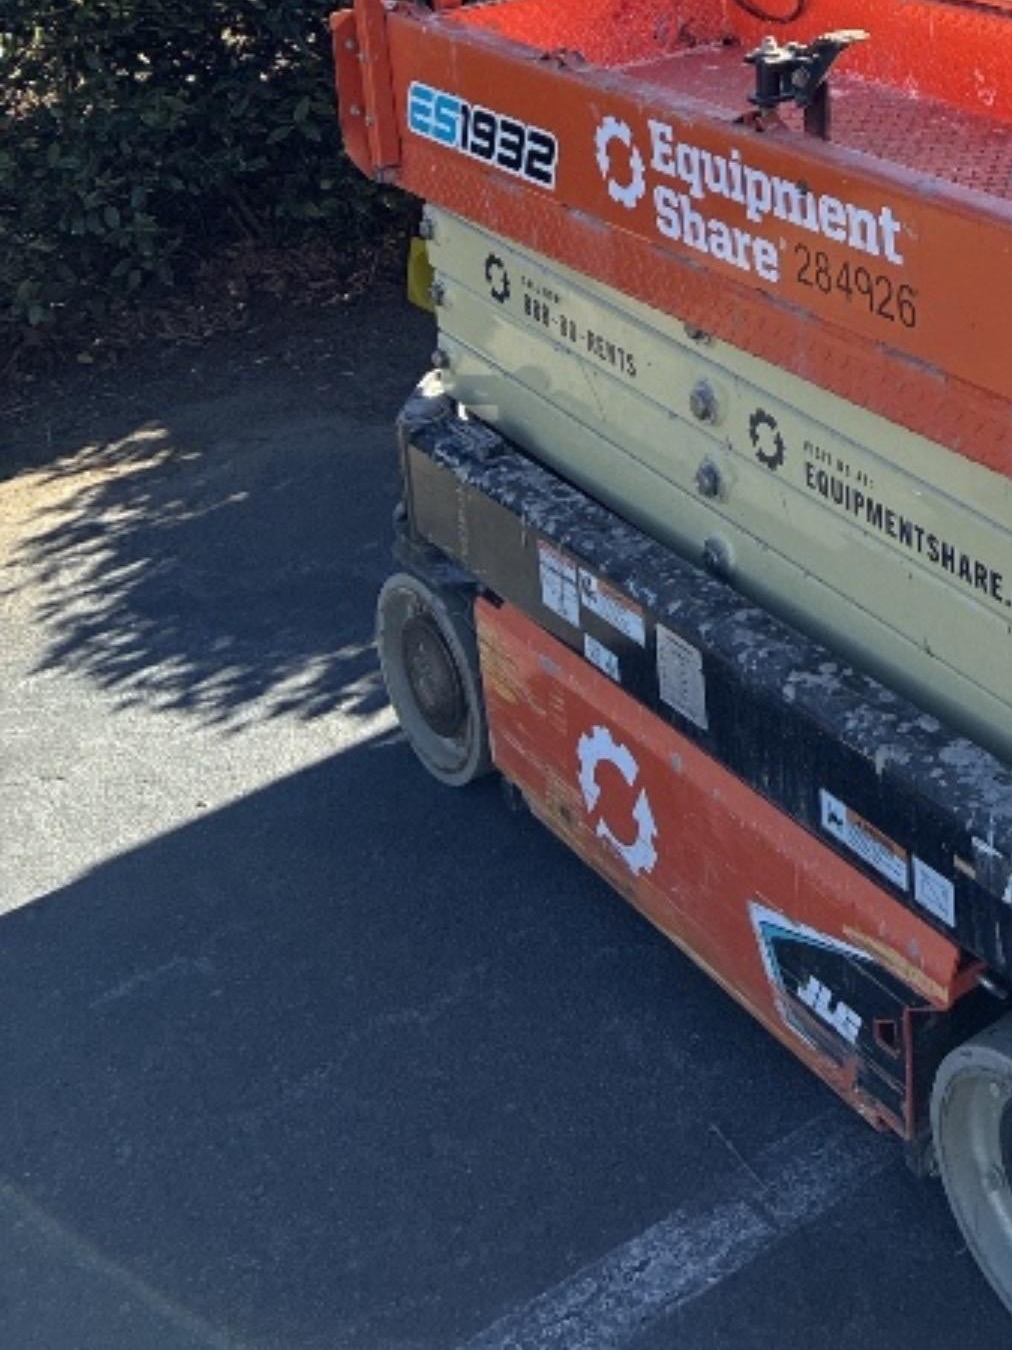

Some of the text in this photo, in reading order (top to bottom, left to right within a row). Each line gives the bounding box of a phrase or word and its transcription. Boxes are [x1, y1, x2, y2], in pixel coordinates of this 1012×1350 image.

[406, 81, 559, 188] ES1932
[647, 119, 904, 265] Equipment
[654, 186, 781, 283] Share
[794, 242, 918, 329] 284926
